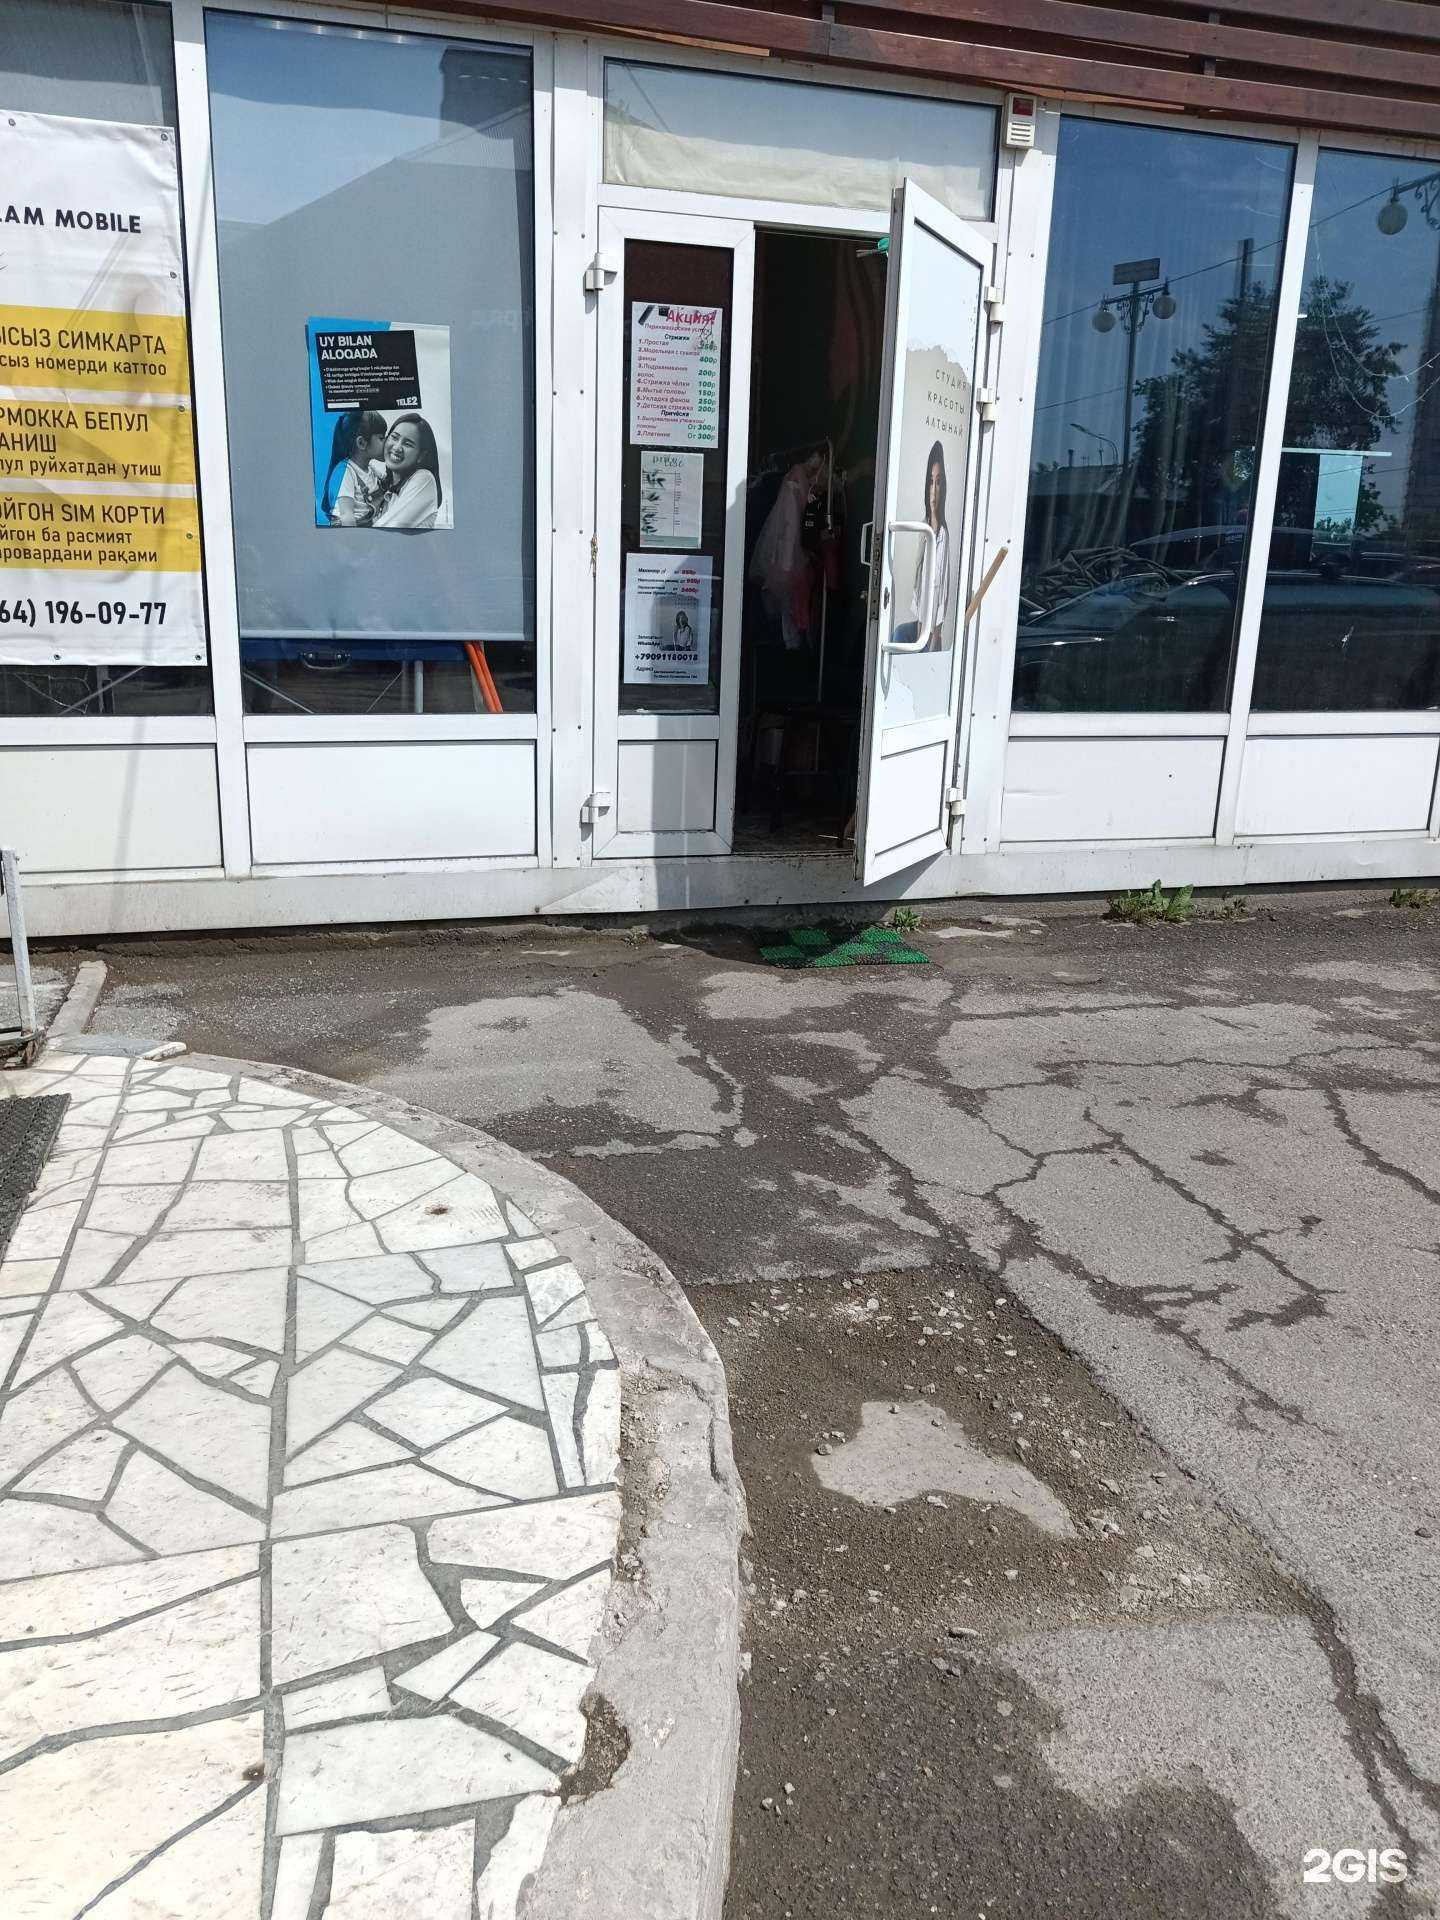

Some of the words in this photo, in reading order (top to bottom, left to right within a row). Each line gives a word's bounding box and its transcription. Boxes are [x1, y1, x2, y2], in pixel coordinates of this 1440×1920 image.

[0, 205, 44, 226] AM
[55, 208, 142, 234] MOBILE
[58, 329, 167, 355] СИМКАРТА
[319, 335, 335, 347] UY
[338, 335, 372, 347] BILAN
[321, 348, 378, 360] ALOQADA
[36, 356, 108, 376] номерди
[114, 360, 167, 377] каттоо
[395, 396, 418, 407] TELE2
[927, 390, 965, 415] КРАСОТЫ
[85, 411, 149, 433] БЕПУЛ
[30, 455, 116, 477] руйхатдан
[122, 463, 162, 478] утиш
[0, 496, 55, 522] ЙГОН
[61, 503, 95, 523] SIM
[102, 504, 166, 525] КОРТИ
[42, 526, 60, 542] ба
[66, 530, 133, 547] расмият
[0, 547, 92, 564] ровардани
[99, 549, 158, 564] рақами
[45, 600, 167, 626] 196-09-77
